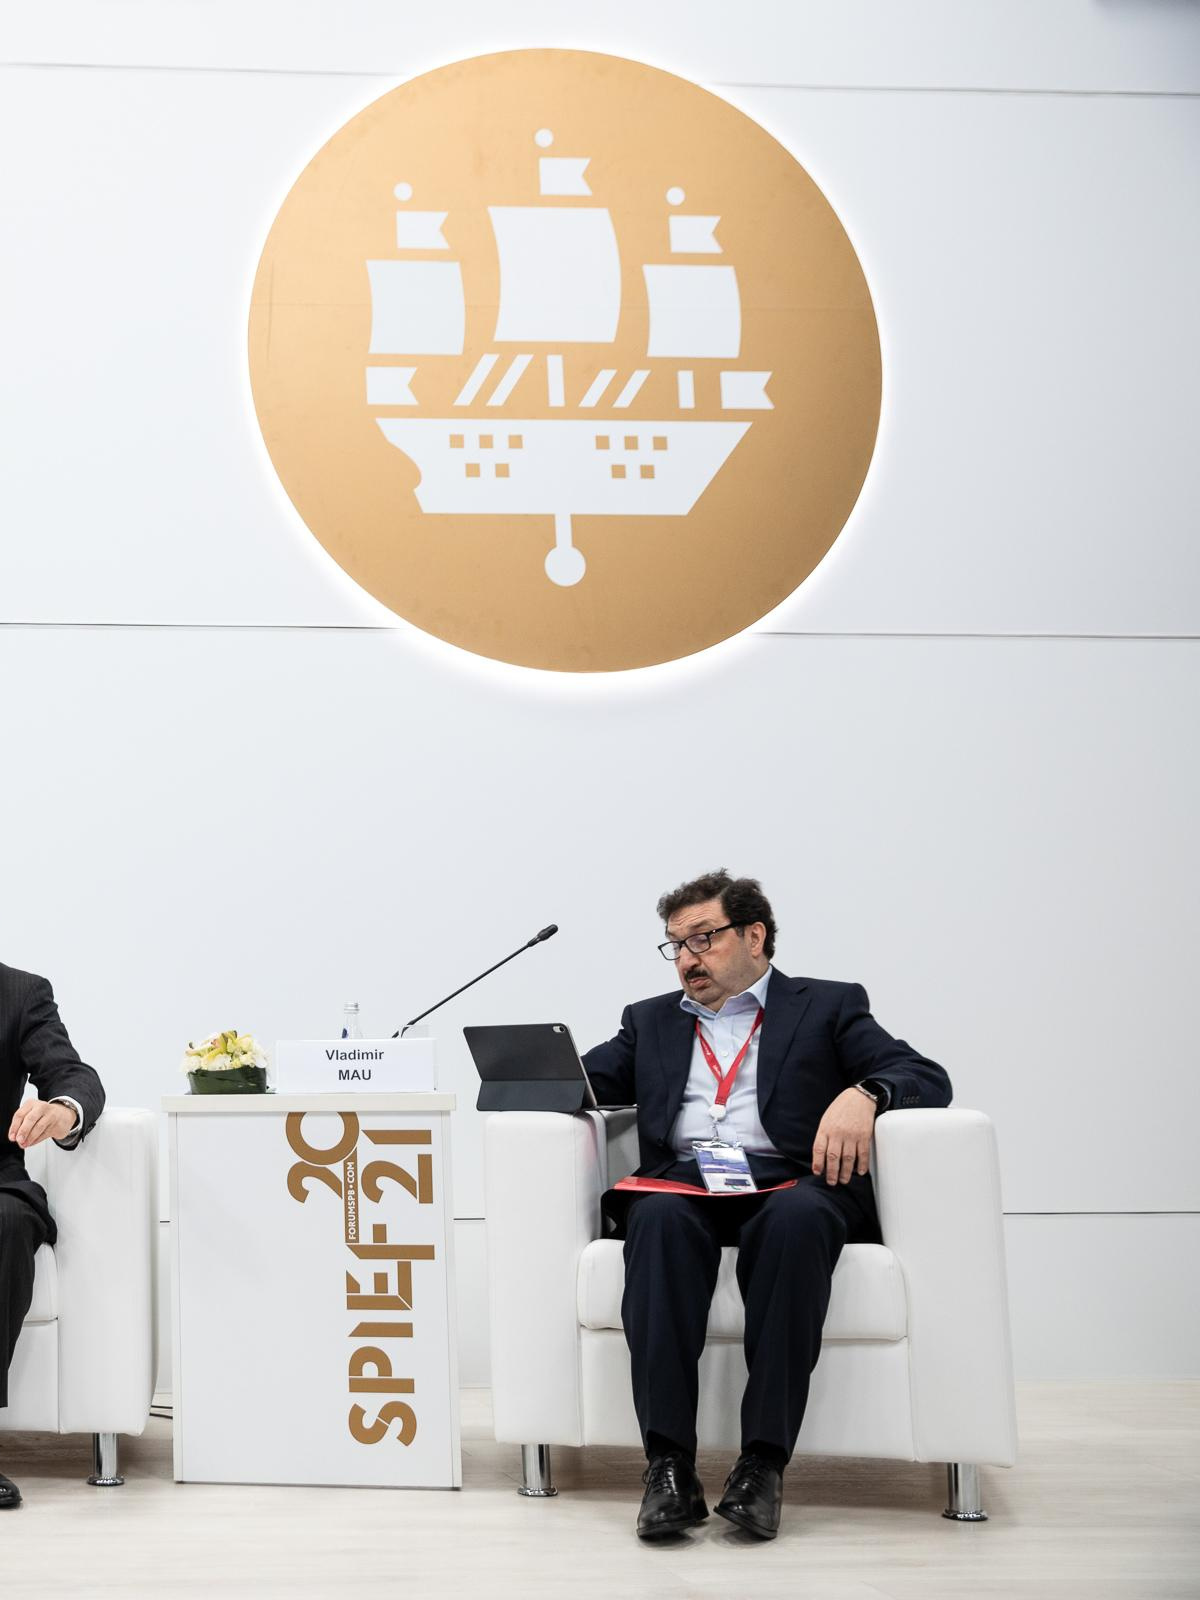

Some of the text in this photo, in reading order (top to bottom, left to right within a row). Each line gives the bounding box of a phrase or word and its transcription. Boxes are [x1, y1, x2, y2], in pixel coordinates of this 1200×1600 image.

[325, 1048, 384, 1061] Vladimir
[338, 1069, 372, 1081] MAU
[346, 1223, 435, 1447] SPIEF
